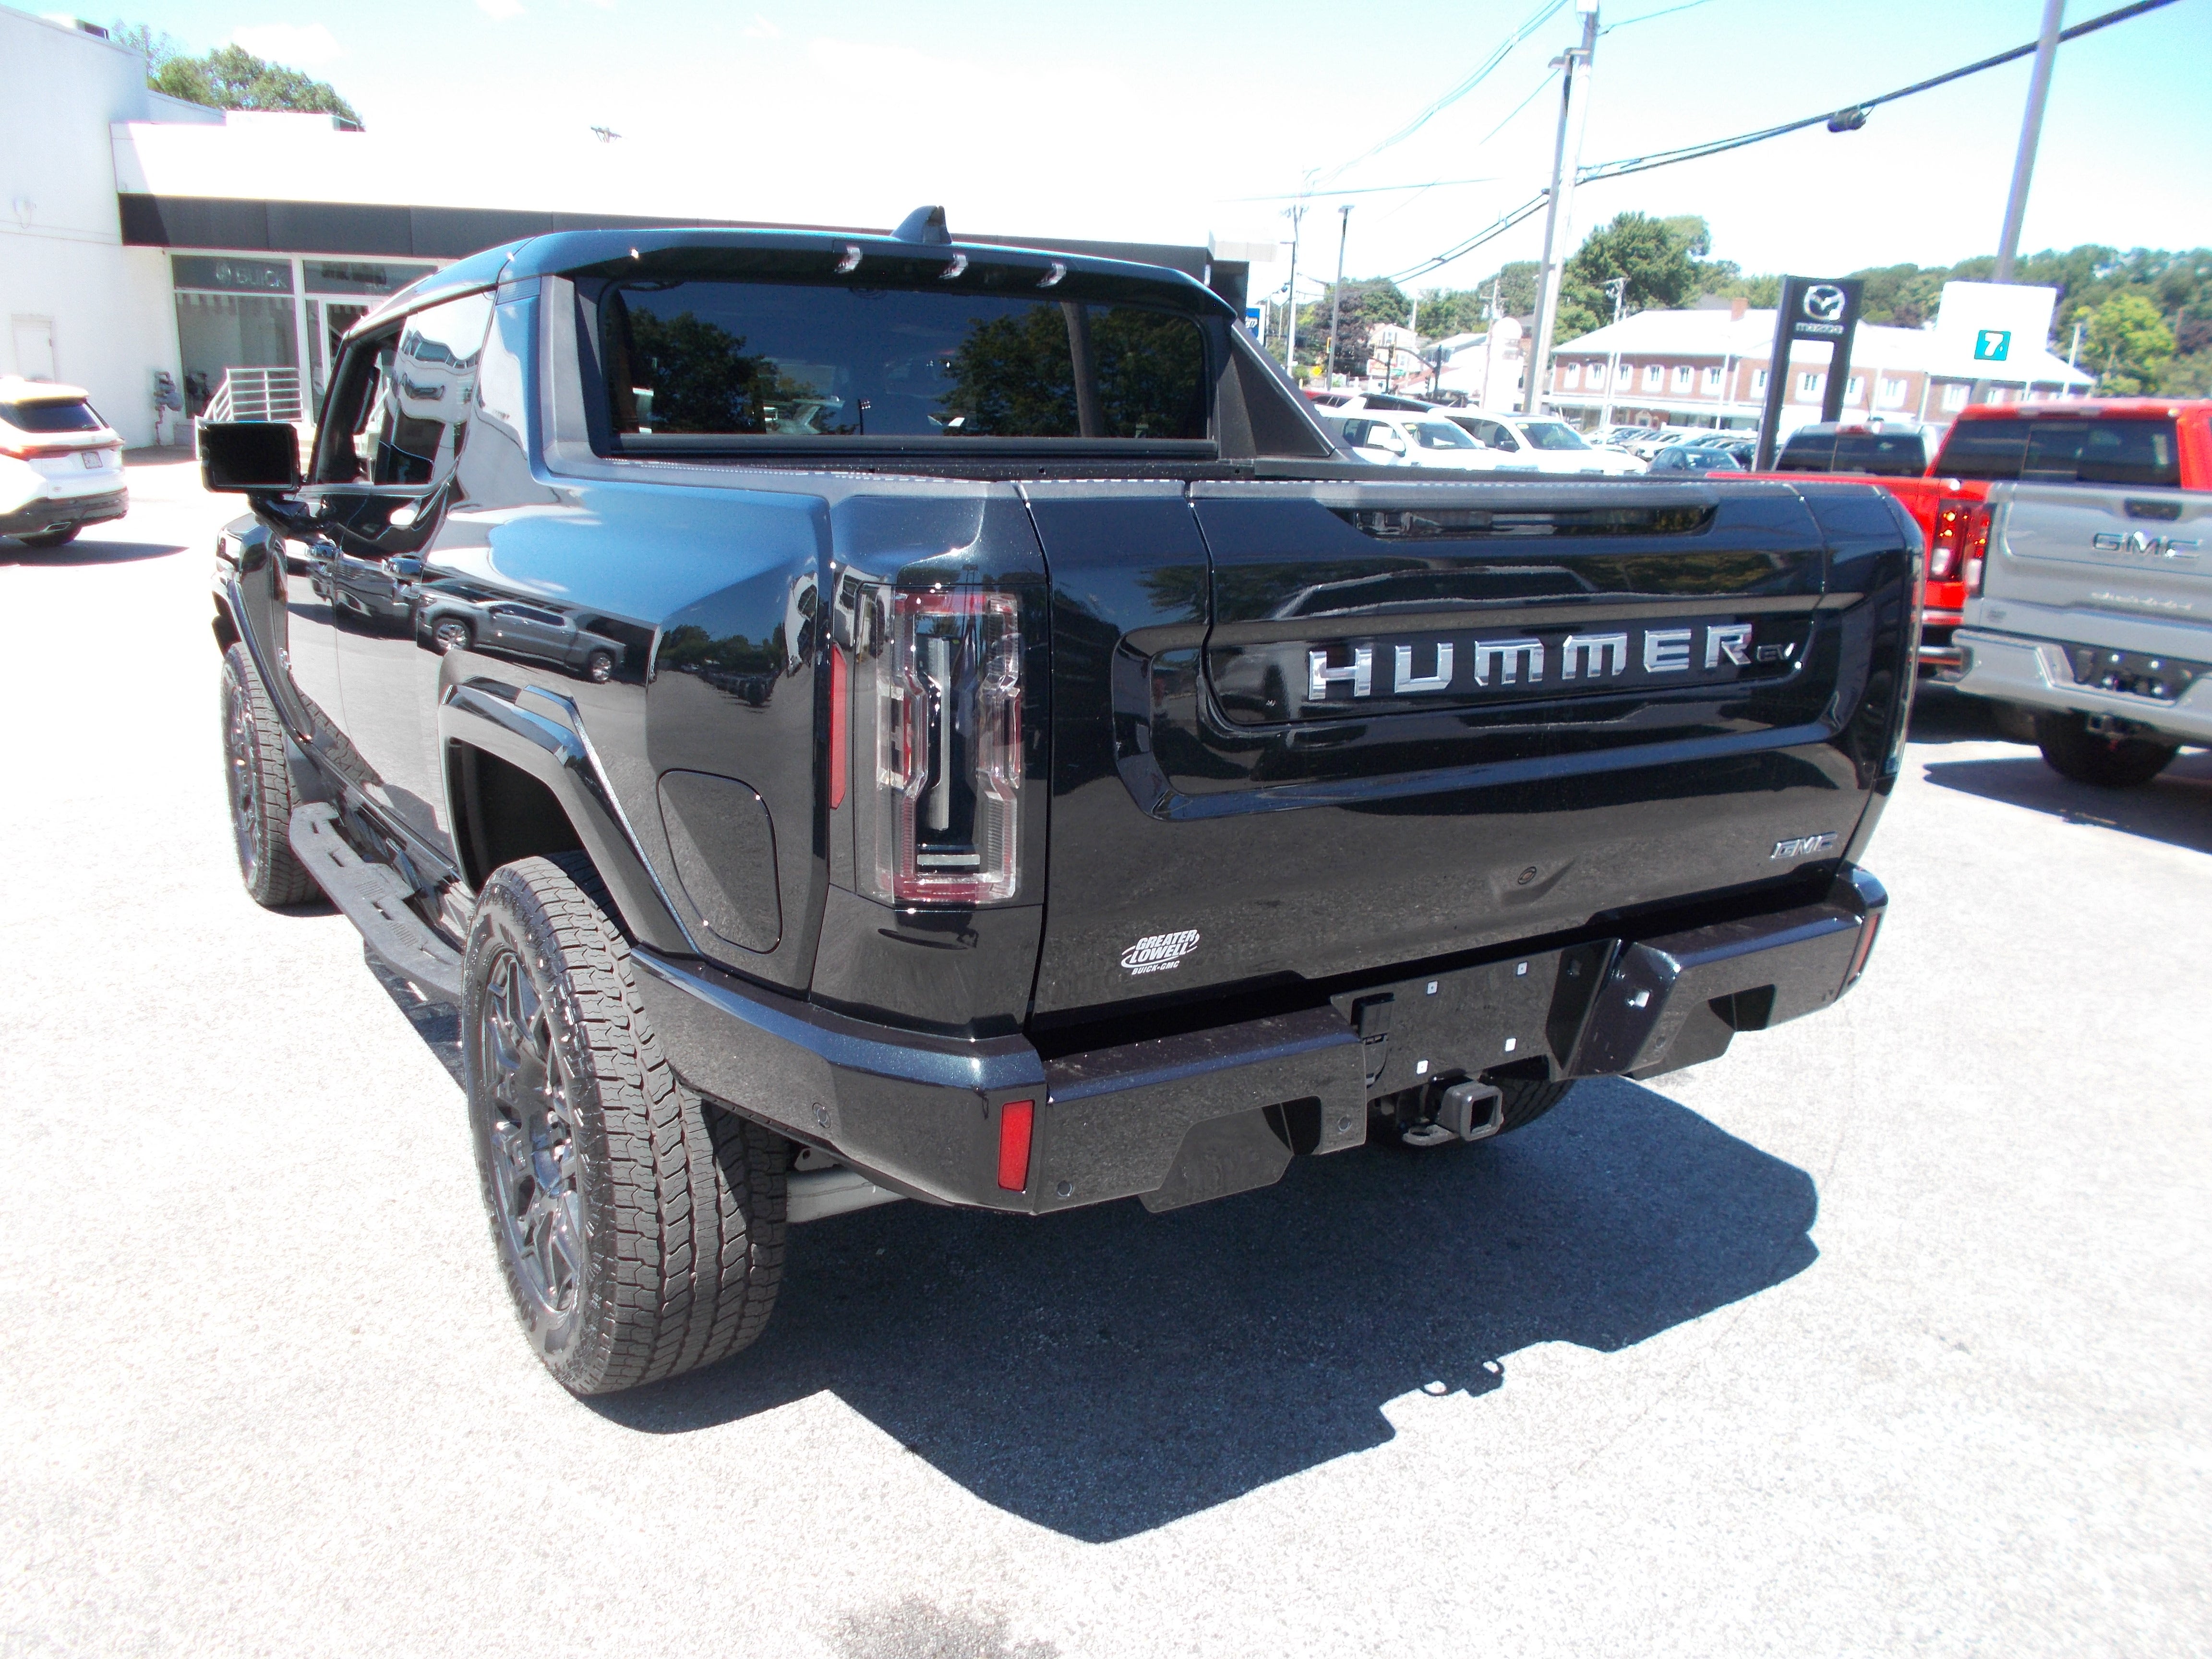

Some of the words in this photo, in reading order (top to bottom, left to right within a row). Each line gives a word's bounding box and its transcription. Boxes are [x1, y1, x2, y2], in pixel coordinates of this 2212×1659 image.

[2092, 531, 2202, 558] GMC
[1308, 623, 1753, 700] HUMMER
[1757, 643, 1795, 661] EV
[1770, 831, 1838, 859] GMC
[1129, 942, 1188, 963] LOWELL
[1136, 929, 1197, 950] GREATER
